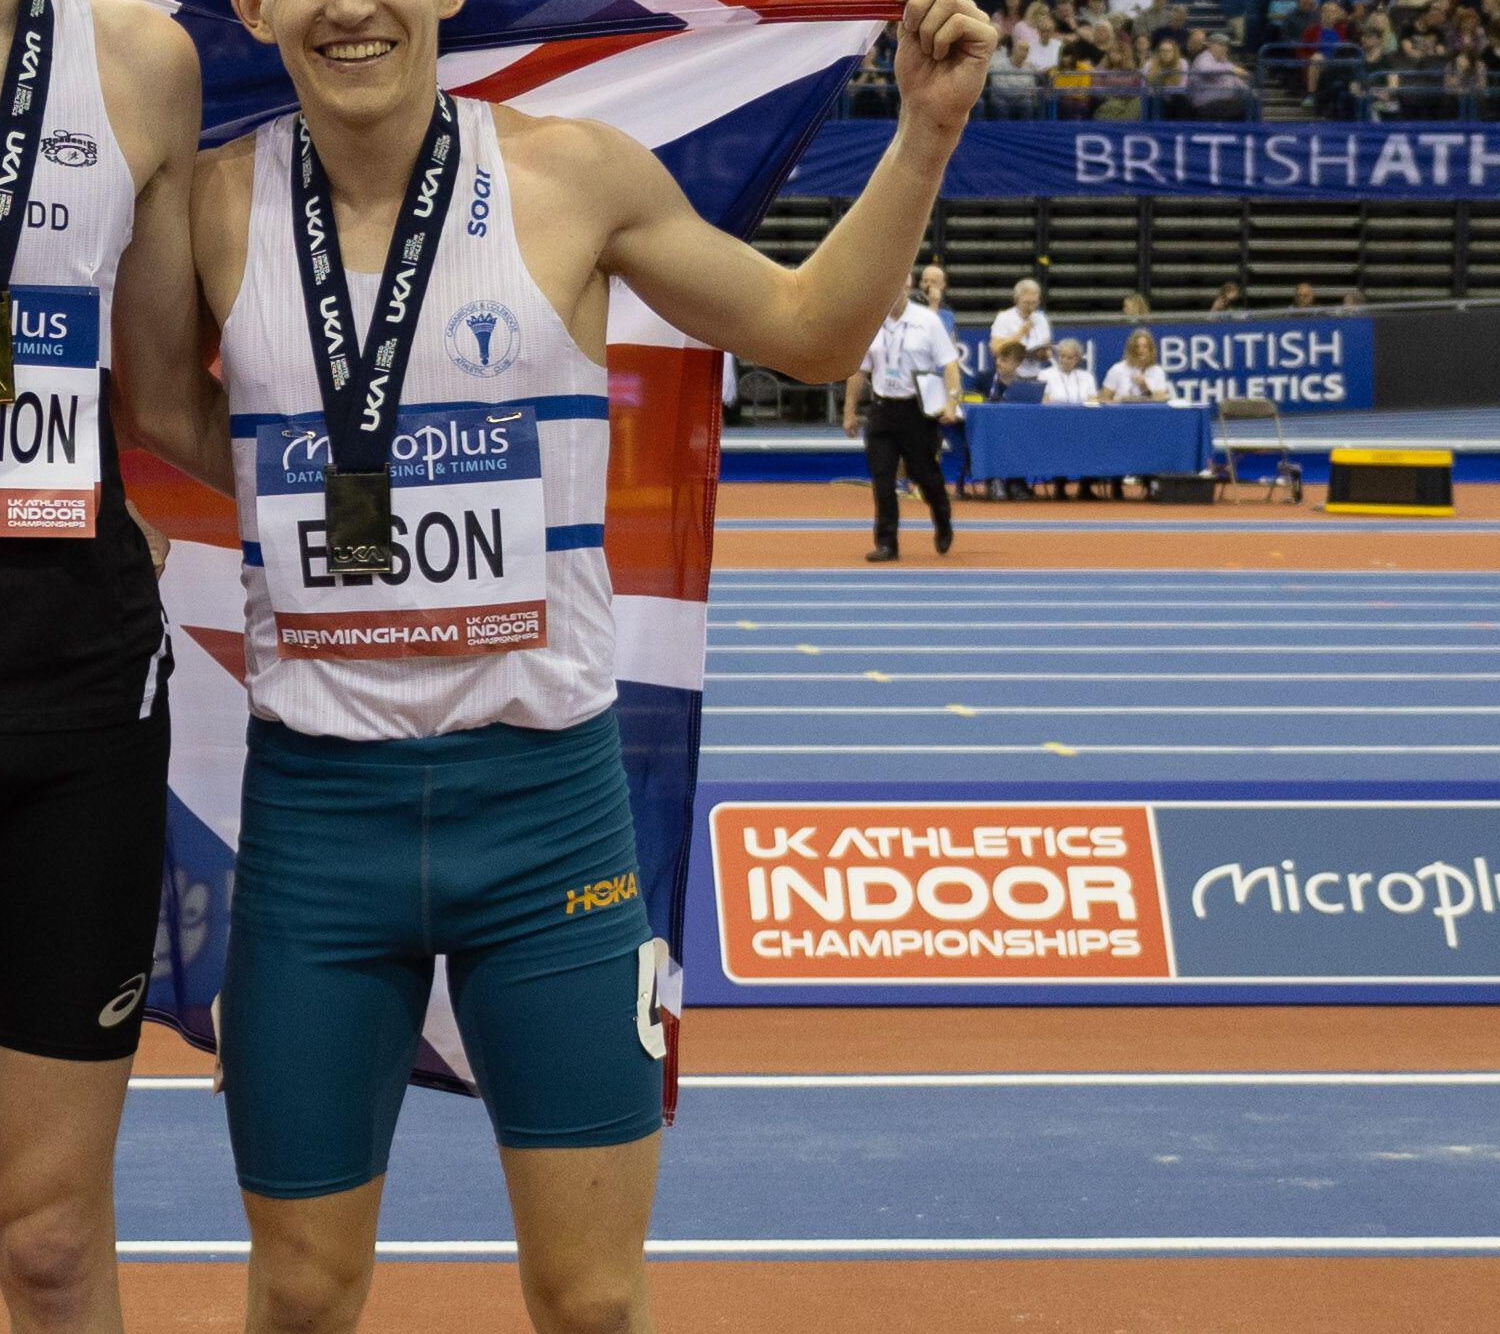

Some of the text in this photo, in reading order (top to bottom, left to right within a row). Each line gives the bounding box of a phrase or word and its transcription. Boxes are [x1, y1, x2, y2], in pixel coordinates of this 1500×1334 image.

[18, 31, 42, 81] UKA
[413, 167, 443, 218] UKA
[467, 165, 491, 238] soar
[305, 196, 326, 251] UKA
[386, 268, 416, 323] UKA
[319, 295, 345, 355] UKA
[1159, 328, 1343, 373] BRITISH
[360, 375, 389, 432] UKA
[282, 420, 509, 481] Moplus
[435, 461, 446, 474] &
[449, 458, 508, 473] TIMING
[8, 498, 86, 508] UK ATHLETICS
[8, 507, 86, 522] INDOOR
[8, 519, 86, 528] CHAMPIONSHIPS
[297, 508, 504, 589] ESON
[333, 545, 386, 564] UKA
[283, 624, 459, 646] BIRMINGHAM
[466, 610, 539, 625] UK ATHLETICS
[466, 619, 539, 638] INDOOR
[743, 826, 1127, 859] UK ATHLETICS
[566, 872, 638, 915] HOKA
[747, 865, 1136, 922] INDOOR
[751, 929, 1142, 959] CHAMPIONSHIPS
